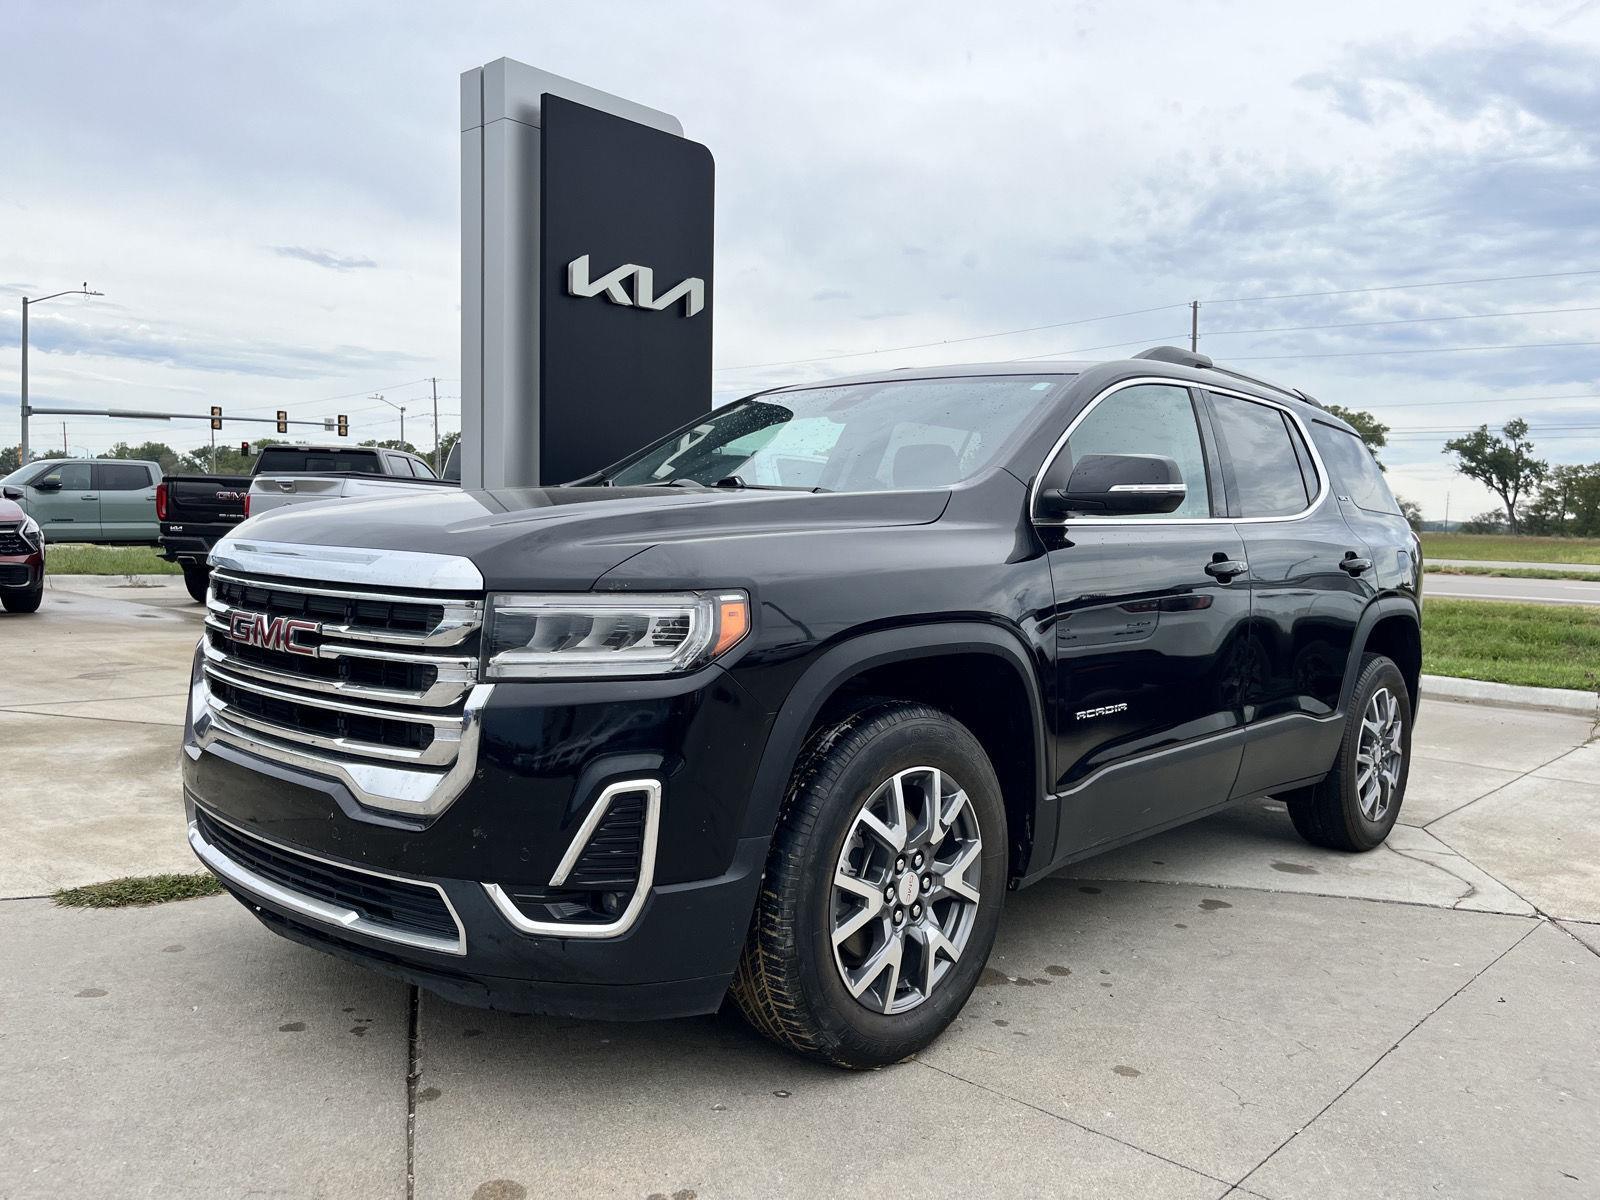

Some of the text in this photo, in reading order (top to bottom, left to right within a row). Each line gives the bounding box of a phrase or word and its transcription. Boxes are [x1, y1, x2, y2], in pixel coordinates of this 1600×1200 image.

[568, 254, 704, 317] KIA
[216, 491, 246, 501] GM
[230, 609, 321, 658] GMC
[1076, 703, 1128, 720] ACADIA
